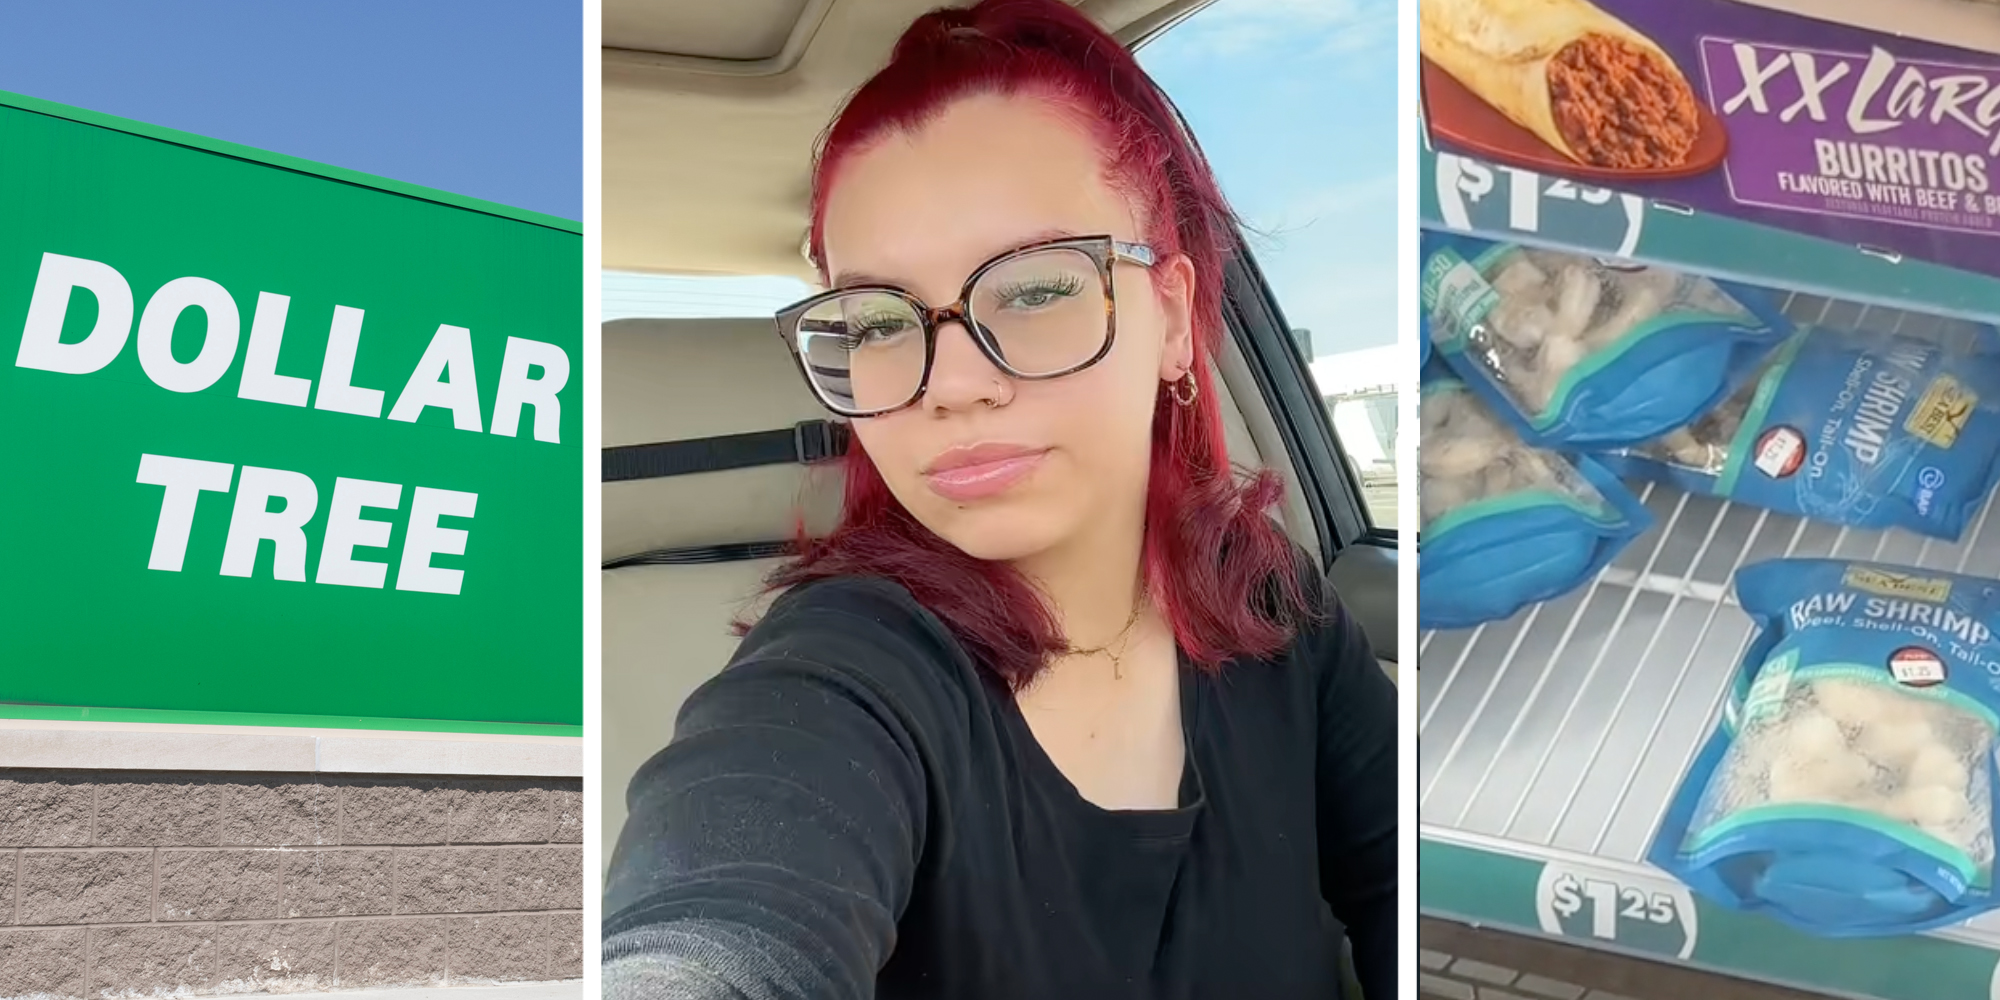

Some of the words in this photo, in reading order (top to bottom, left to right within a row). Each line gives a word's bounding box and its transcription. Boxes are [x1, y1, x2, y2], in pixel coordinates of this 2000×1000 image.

[1777, 171, 1863, 200] FLAVORED
[1865, 183, 1911, 206] WITH
[1915, 188, 1958, 211] BEEF
[1964, 192, 1980, 213] &
[1814, 138, 1989, 193] BURRITOS
[15, 252, 570, 444] DOLLAR
[1844, 371, 1911, 465] SHRIMP
[1810, 417, 1842, 478] Tail-On
[136, 453, 478, 595] TREE
[1790, 592, 1857, 631] RAW
[1864, 598, 1991, 645] SHRIMP
[1949, 641, 2000, 676] Tail-O
